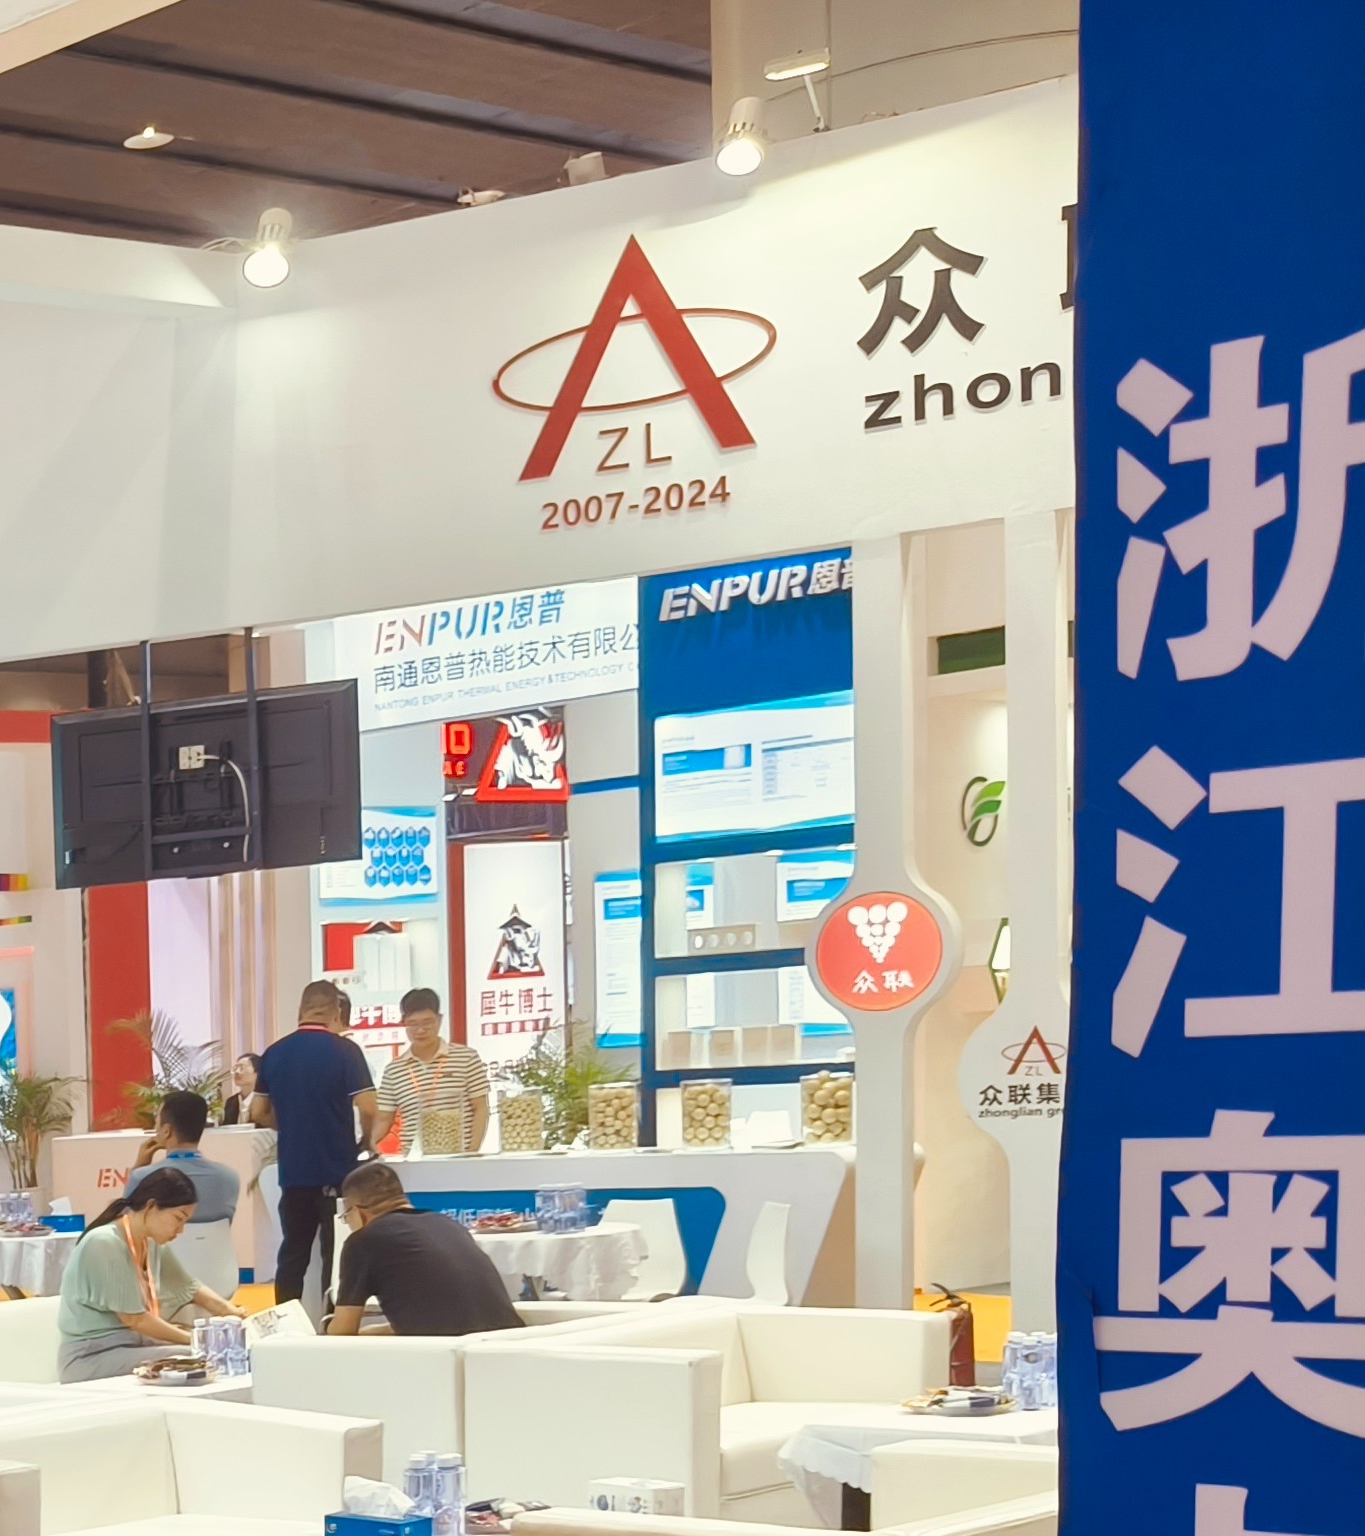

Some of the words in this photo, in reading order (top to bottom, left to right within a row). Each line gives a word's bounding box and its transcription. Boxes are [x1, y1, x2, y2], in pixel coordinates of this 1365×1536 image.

[597, 422, 673, 473] ZL
[540, 475, 731, 531] 2007-2024
[979, 1082, 1061, 1106] 众联集
[978, 1106, 1043, 1120] zhonglian
[1047, 1108, 1063, 1119] gr
